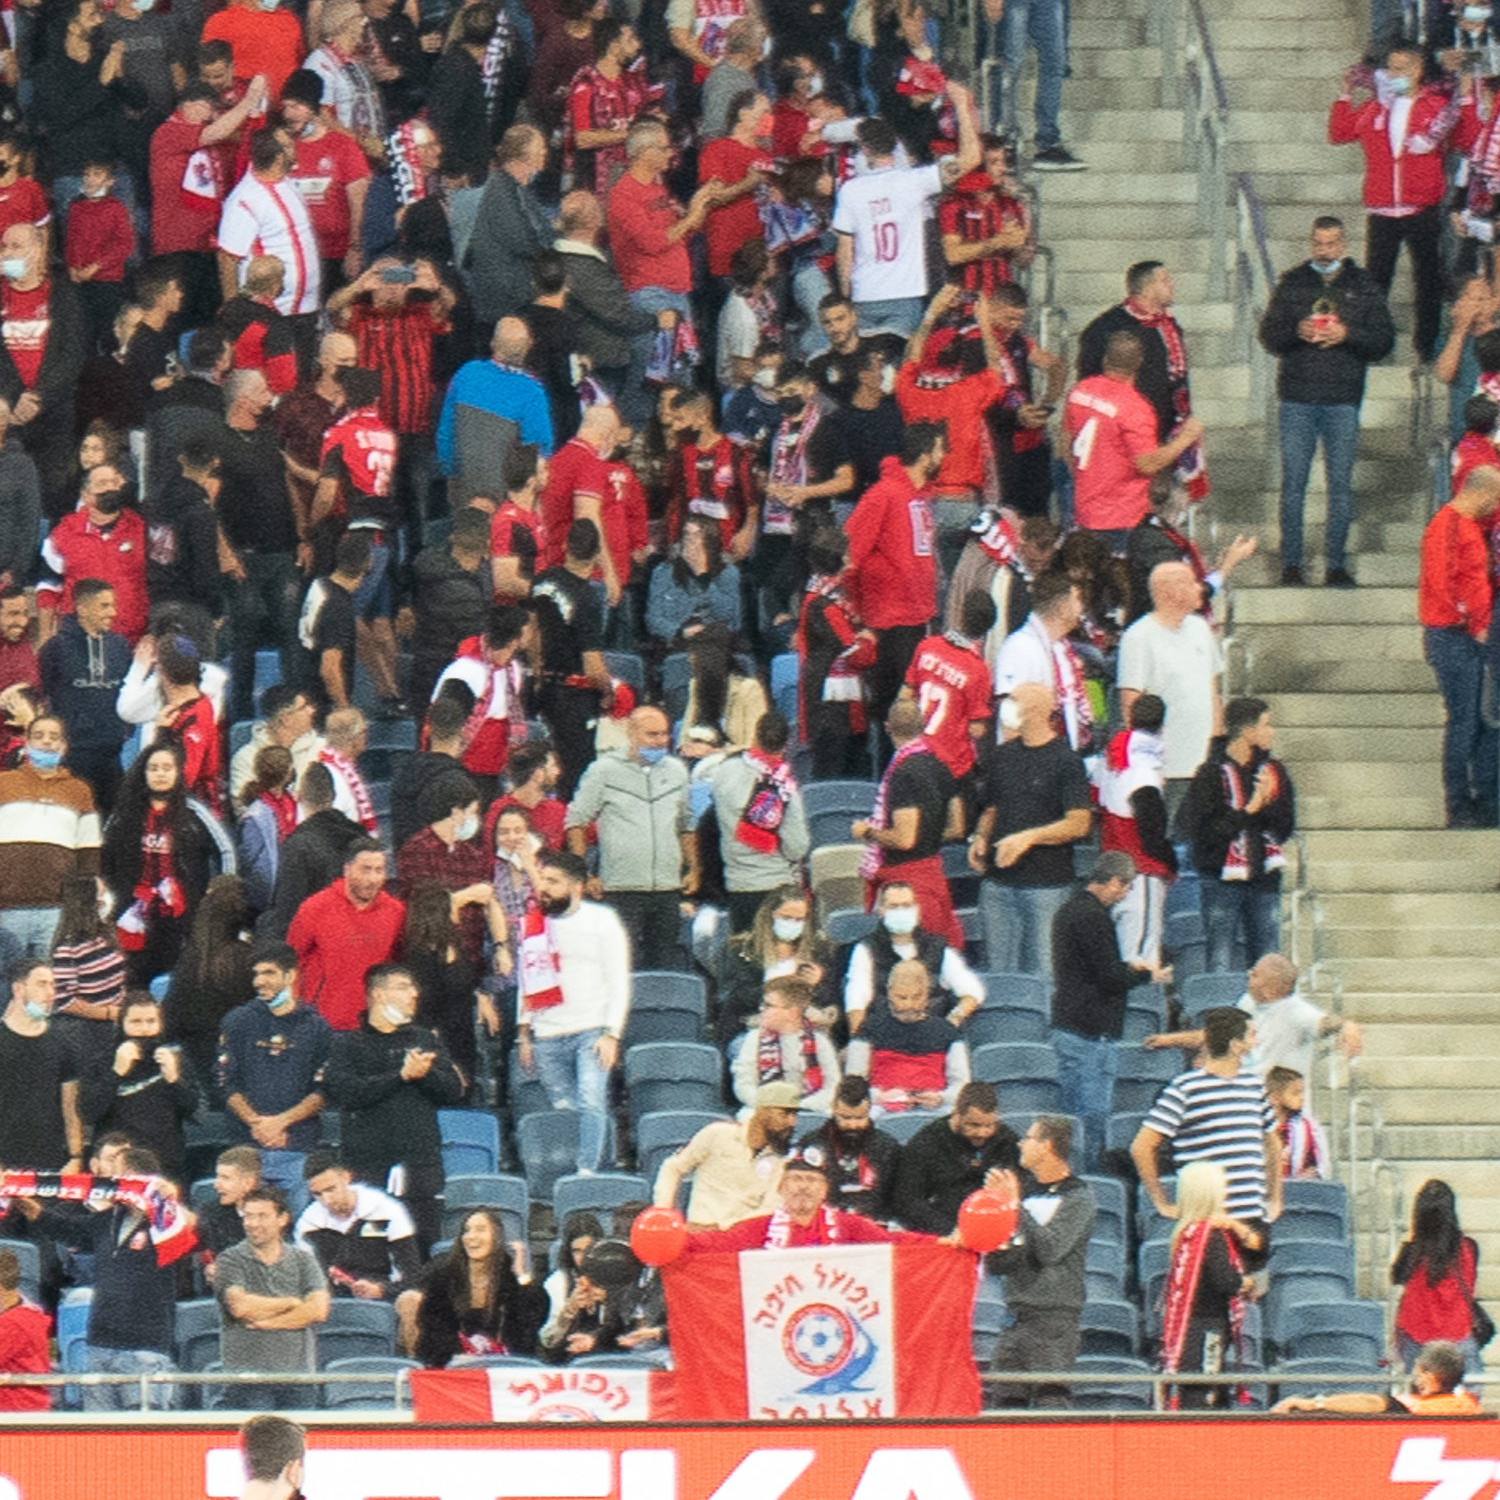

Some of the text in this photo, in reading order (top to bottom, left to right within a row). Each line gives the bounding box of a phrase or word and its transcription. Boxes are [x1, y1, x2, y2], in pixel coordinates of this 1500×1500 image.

[872, 221, 899, 263] 10
[753, 1263, 881, 1329] הפועל חיפה
[508, 1373, 631, 1411] הפועל
